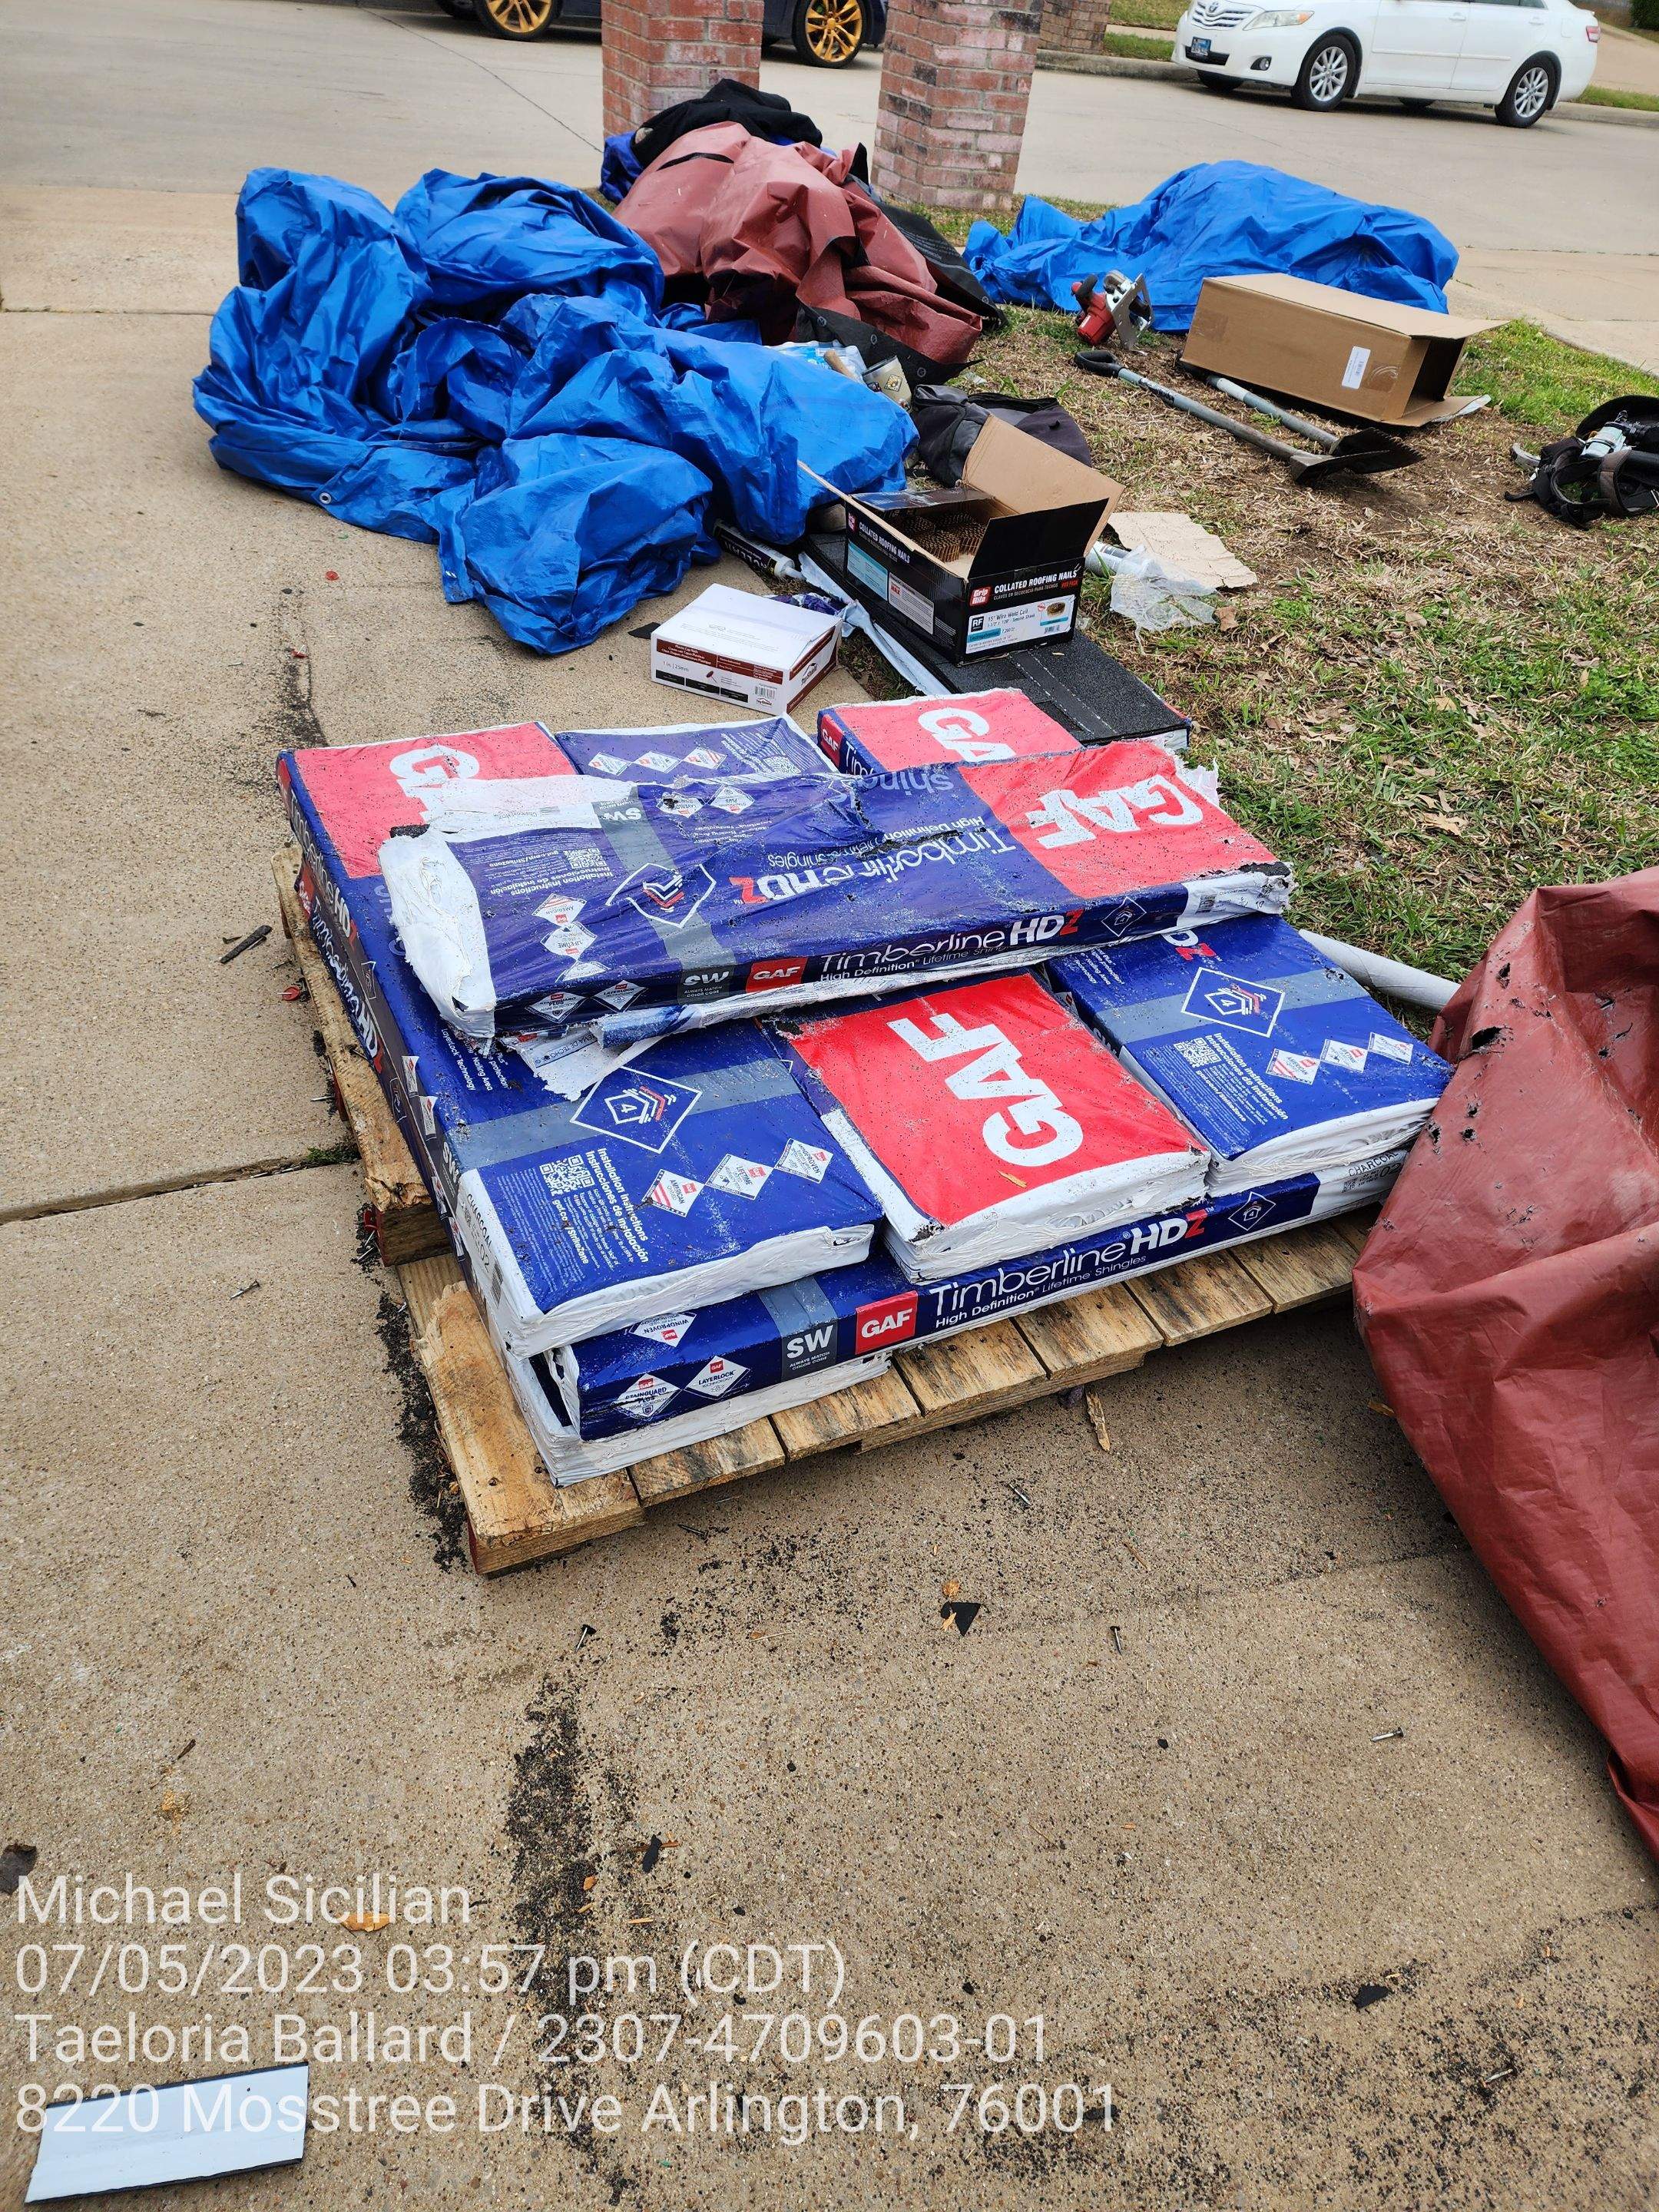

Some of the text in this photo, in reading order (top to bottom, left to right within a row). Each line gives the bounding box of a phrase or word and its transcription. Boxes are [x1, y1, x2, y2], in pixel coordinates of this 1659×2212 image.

[859, 522, 879, 542] COLLATED
[878, 536, 897, 555] ROOFING
[897, 548, 910, 564] NAILS
[973, 588, 988, 598] Grip
[994, 570, 1078, 594] COLLATED ROOFING NAILS
[972, 596, 986, 604] Rite
[972, 618, 983, 628] RF
[821, 727, 839, 752] GAF
[952, 816, 986, 830] High
[1025, 774, 1204, 849] GAF
[563, 870, 614, 883] Installation
[545, 906, 575, 915] AMERICAN
[820, 909, 1085, 973] Timberline HDZ
[683, 971, 730, 987] SW
[753, 966, 800, 981] GAF
[821, 972, 849, 982] High
[550, 1045, 570, 1058] TECHO
[457, 1057, 476, 1091] Technology
[472, 1056, 493, 1091] Nailing Area
[1205, 1035, 1243, 1075] Instrucciones
[1242, 1077, 1253, 1085] de
[1251, 1084, 1288, 1119] instalación
[1214, 1033, 1247, 1068] Installation
[1245, 1068, 1282, 1103] instructions
[886, 1013, 1084, 1167] GAF
[1196, 1071, 1246, 1121] gaf.com/StrikeZone
[621, 1103, 637, 1114] 4
[797, 1144, 821, 1174] WINDPROVEN
[1348, 1151, 1399, 1177] CHARCOAL
[1380, 1162, 1402, 1178] 02
[737, 1165, 753, 1186] LIFETIME
[598, 1148, 648, 1241] Installation instructions
[670, 1179, 686, 1204] AMERICAN
[586, 1150, 648, 1262] Instrucciones de instalación
[466, 1194, 492, 1253] CHARCOAL
[552, 1200, 588, 1263] gaf.co/StrikeZone
[479, 1243, 491, 1273] 02
[929, 1209, 1208, 1316] Timberline HDZ
[935, 1256, 1147, 1329] High Definition Lifetime Shingles
[643, 1319, 690, 1334] WINDPROVEN
[861, 1308, 913, 1338] GAF
[786, 1325, 833, 1359] SW
[789, 1351, 830, 1368] ALWAYS MATCH
[792, 1356, 827, 1371] COLOR CODE
[638, 1381, 654, 1390] GAF
[698, 1369, 736, 1386] LAYERLOCK
[625, 1386, 667, 1400] STAINGUARD
